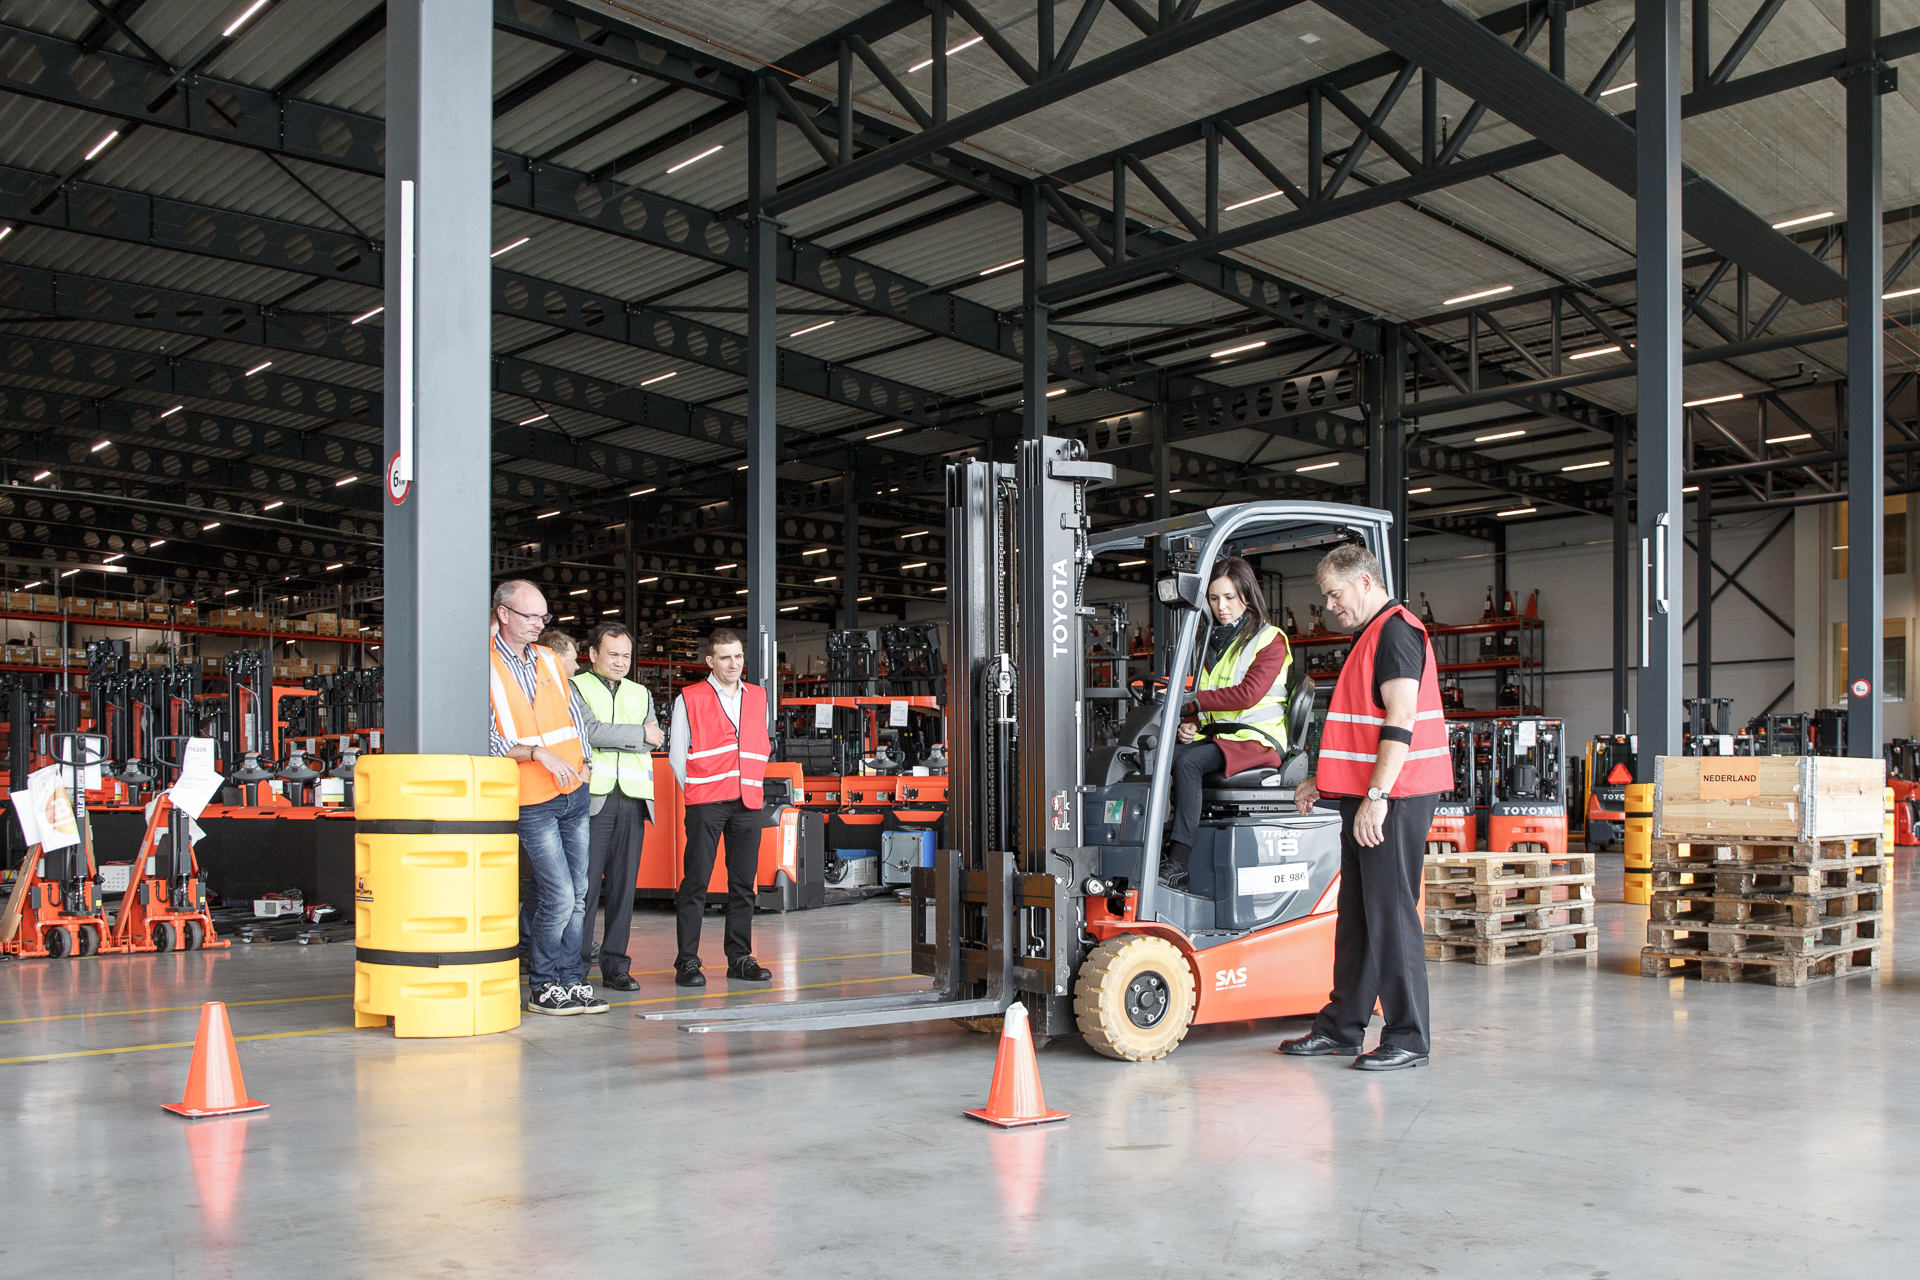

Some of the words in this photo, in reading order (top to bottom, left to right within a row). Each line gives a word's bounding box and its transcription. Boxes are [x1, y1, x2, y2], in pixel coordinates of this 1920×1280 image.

[1052, 558, 1068, 659] TOYOTA
[1703, 774, 1757, 782] NEDERLAND
[77, 784, 84, 792] BT
[1503, 806, 1553, 816] TOYOTA
[1266, 838, 1298, 856] 18
[1274, 874, 1286, 884] DE
[1289, 872, 1306, 882] 986
[1216, 967, 1248, 987] SAS
